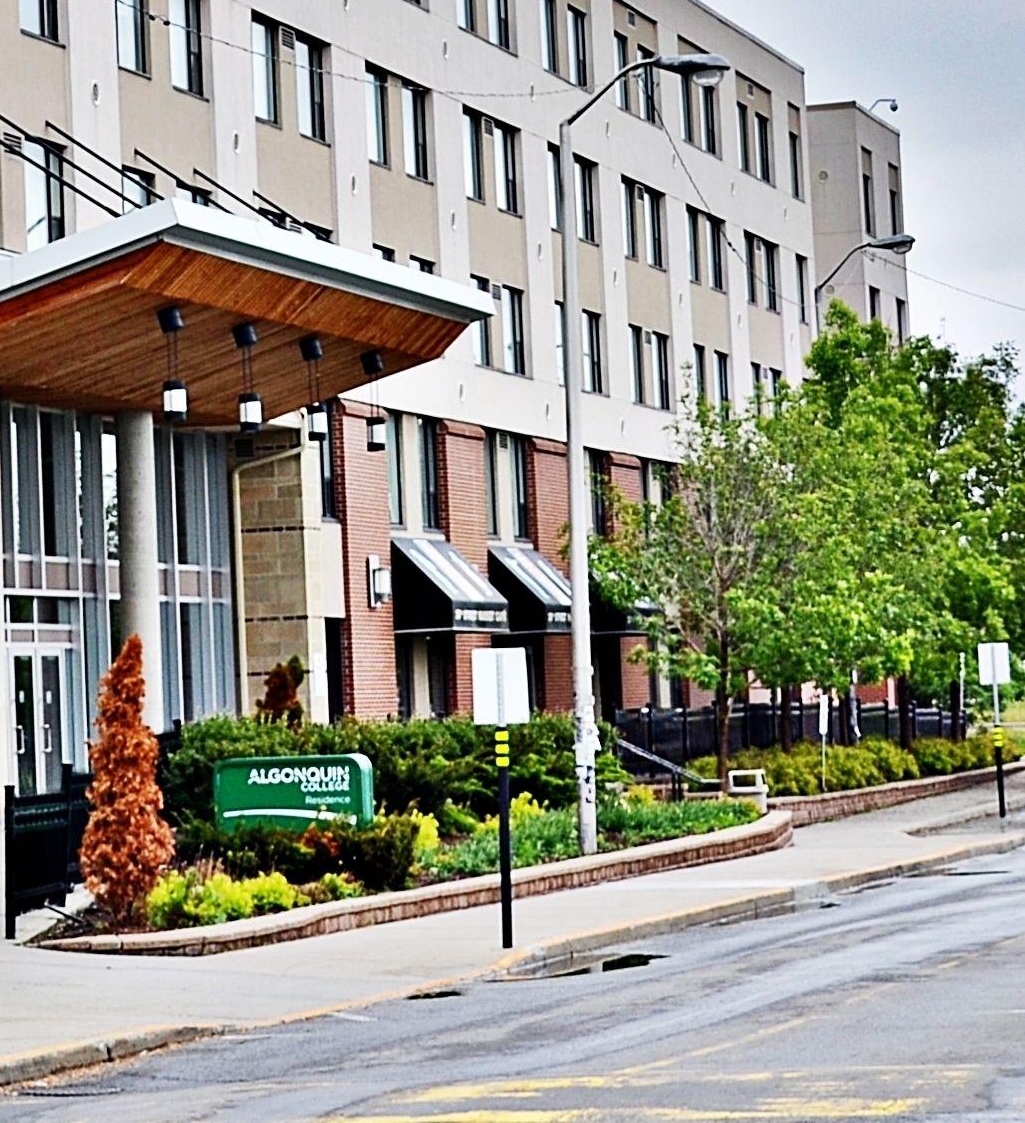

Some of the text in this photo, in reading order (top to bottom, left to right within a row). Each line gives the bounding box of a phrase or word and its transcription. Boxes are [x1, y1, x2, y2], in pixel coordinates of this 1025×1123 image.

[247, 766, 350, 784] ALGONQUIN
[300, 781, 350, 792] COLLEGE
[305, 795, 351, 804] Residence
